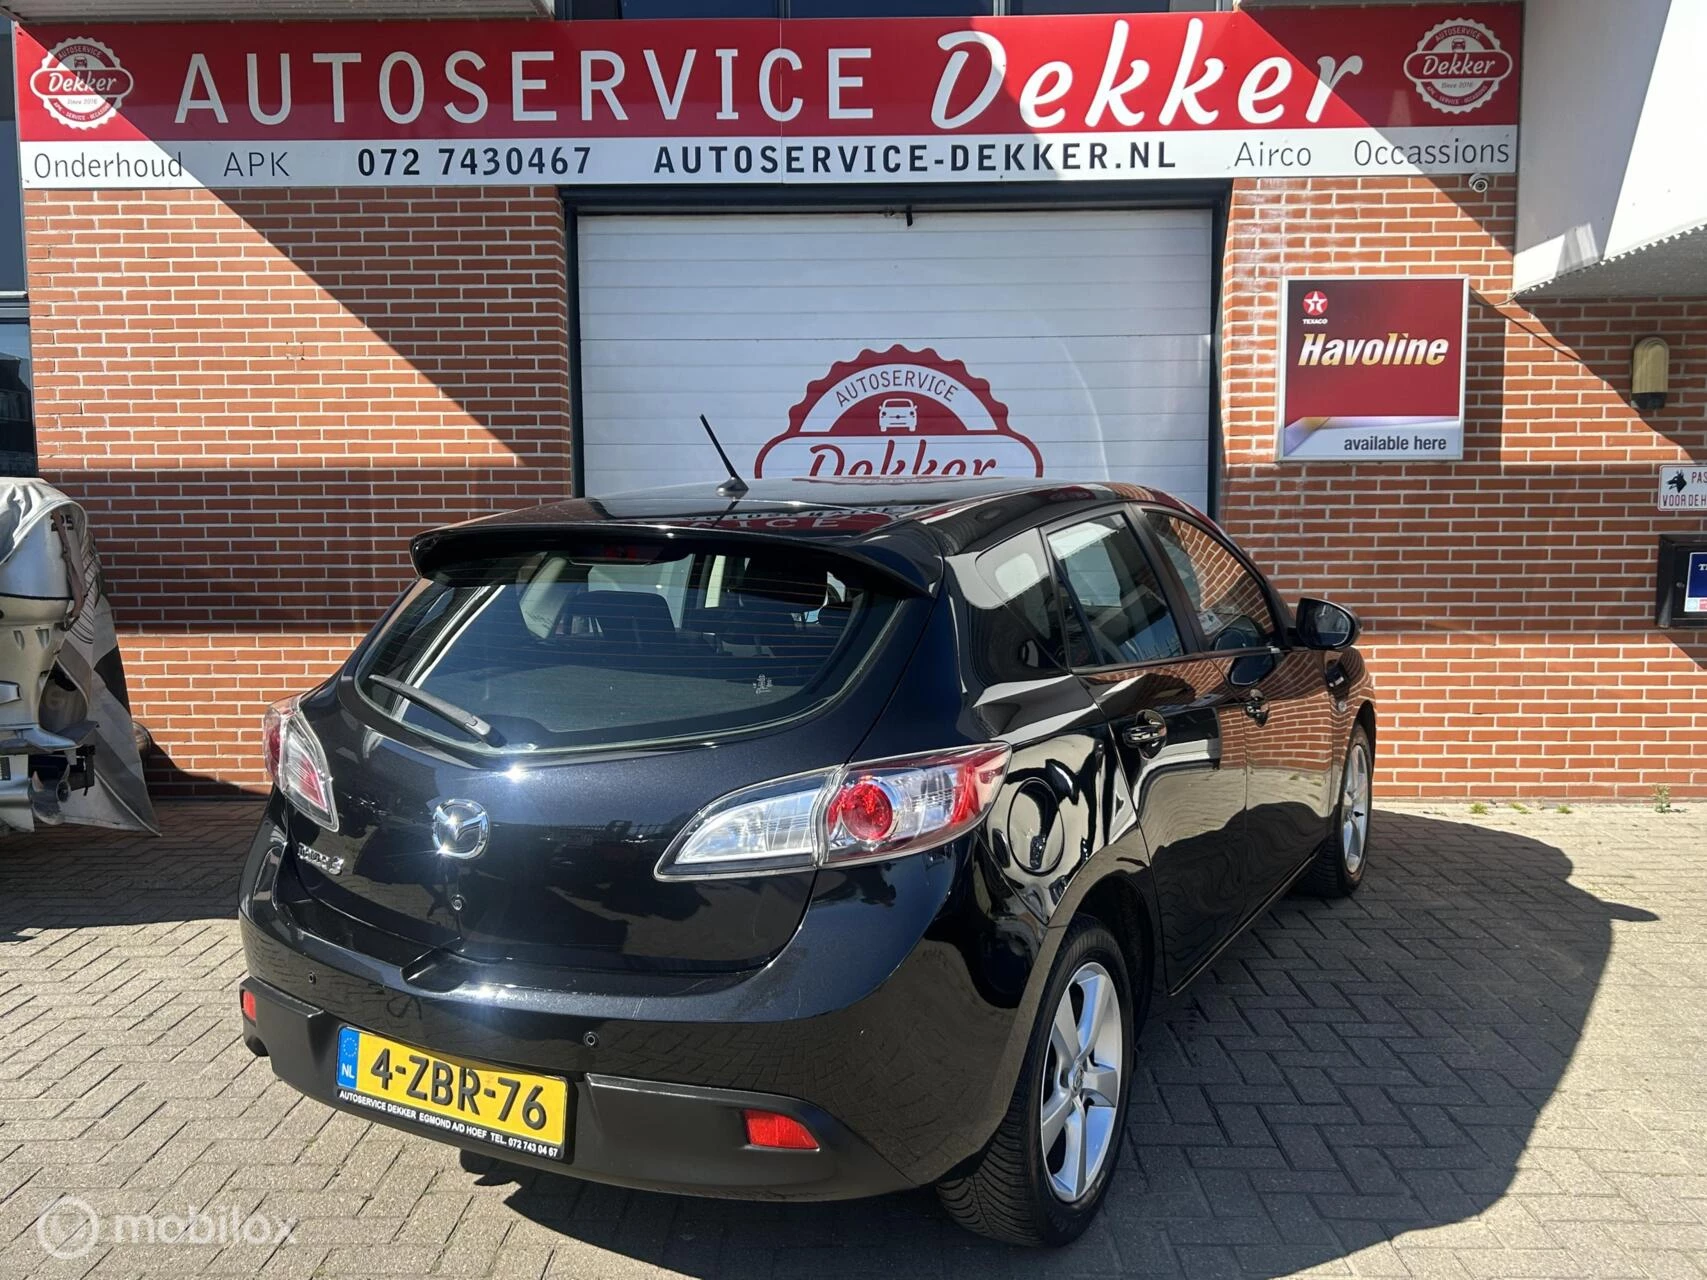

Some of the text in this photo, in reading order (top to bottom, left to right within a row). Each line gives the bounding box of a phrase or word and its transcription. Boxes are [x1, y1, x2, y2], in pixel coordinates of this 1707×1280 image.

[1435, 28, 1481, 41] AUTOSERVICE
[59, 46, 102, 58] AUTOSERVICE
[1423, 53, 1495, 75] Dekker
[49, 72, 116, 91] Dekker
[174, 17, 1363, 130] AUTOSERVICE Dekker
[33, 151, 183, 179] Onderhoud
[224, 151, 290, 177] APK
[357, 146, 591, 176] 072 7430467
[654, 142, 1177, 174] AUTOSERVICE-DEKKER.NL
[1234, 141, 1312, 168] Airco
[1353, 138, 1511, 166] Occassions
[1298, 332, 1449, 366] Havoline
[835, 370, 959, 407] AUTOSERVICE
[1344, 436, 1447, 451] available here
[1662, 494, 1686, 507] VOOR
[1688, 494, 1699, 507] DE
[341, 1063, 355, 1080] NL
[370, 1048, 547, 1131] 4-ZBR-76
[339, 1090, 558, 1157] AUTOSERVICE DEKKER EGMOND A/D HOEF TEL. 072 743 04 67
